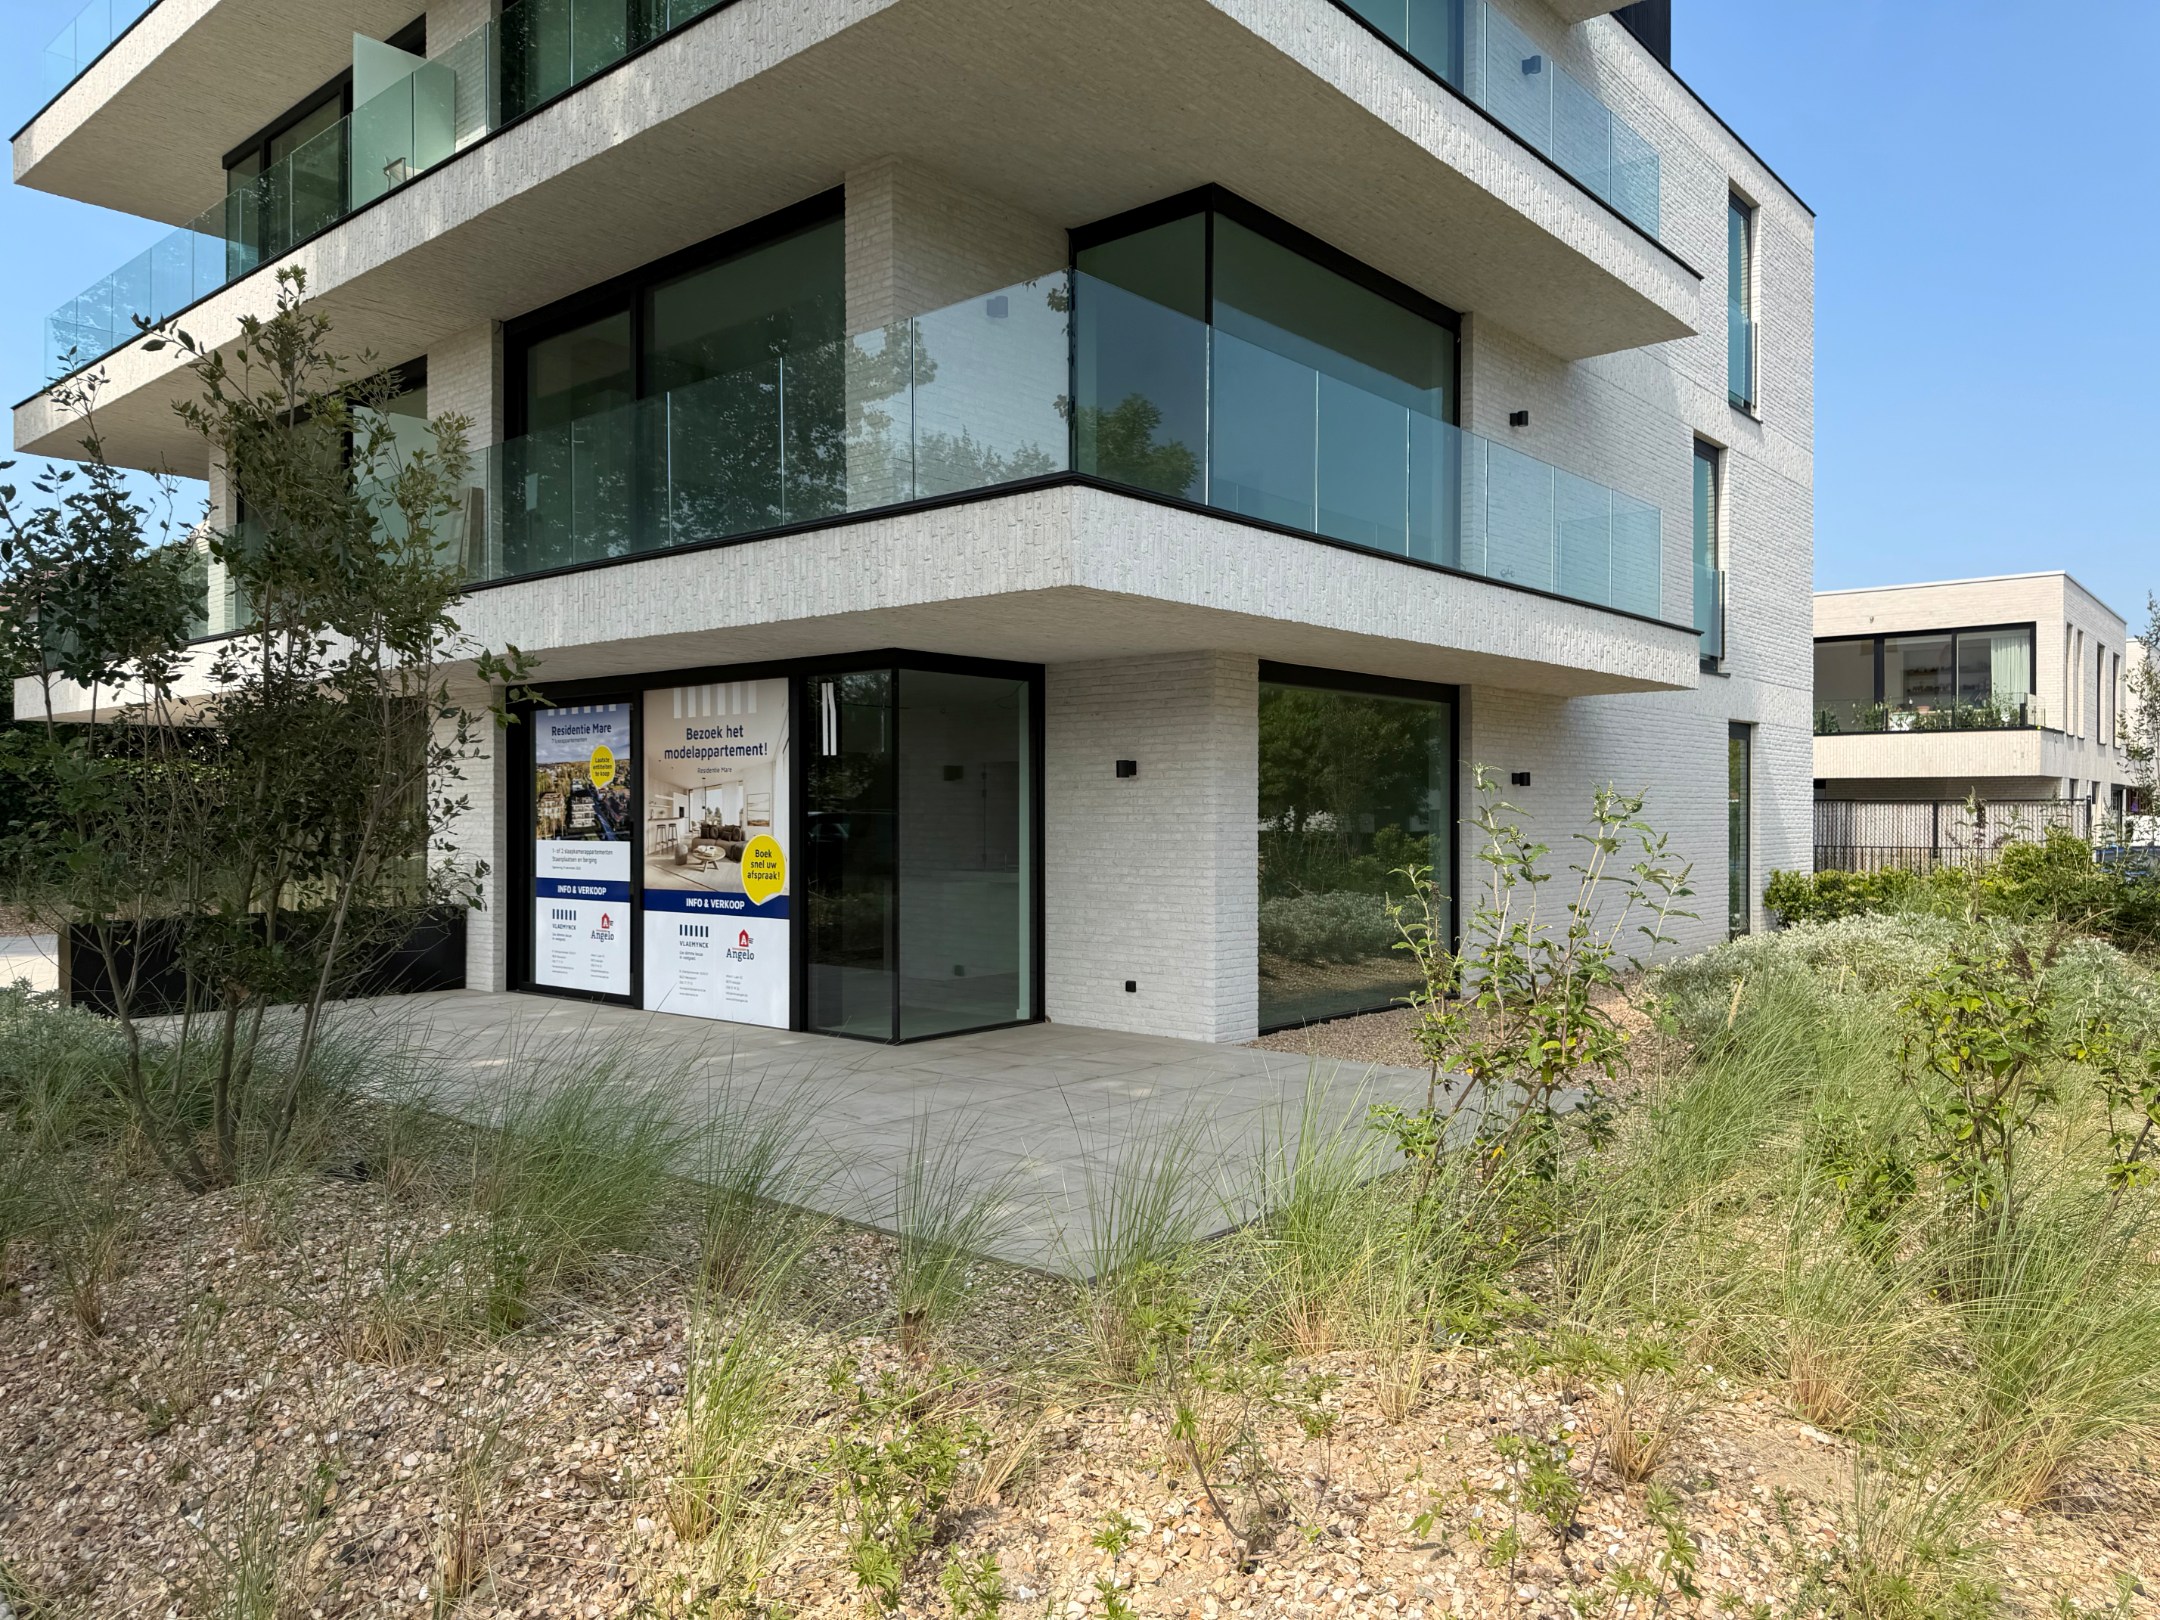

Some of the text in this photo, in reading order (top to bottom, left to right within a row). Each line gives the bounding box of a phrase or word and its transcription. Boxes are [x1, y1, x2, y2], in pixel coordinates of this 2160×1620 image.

[551, 723, 612, 736] Residentie Mare
[686, 725, 744, 740] Bezoek het
[664, 743, 768, 760] modelappartement!
[755, 849, 772, 858] Boek
[751, 860, 765, 869] snel
[747, 871, 780, 881] afspraak!
[557, 884, 607, 895] INFO & VERKOOP
[686, 898, 745, 910] INFO & VERKOOP
[591, 930, 614, 943] Angelo
[679, 940, 709, 949] VLAEMYNCK
[726, 947, 755, 962] Angelo
